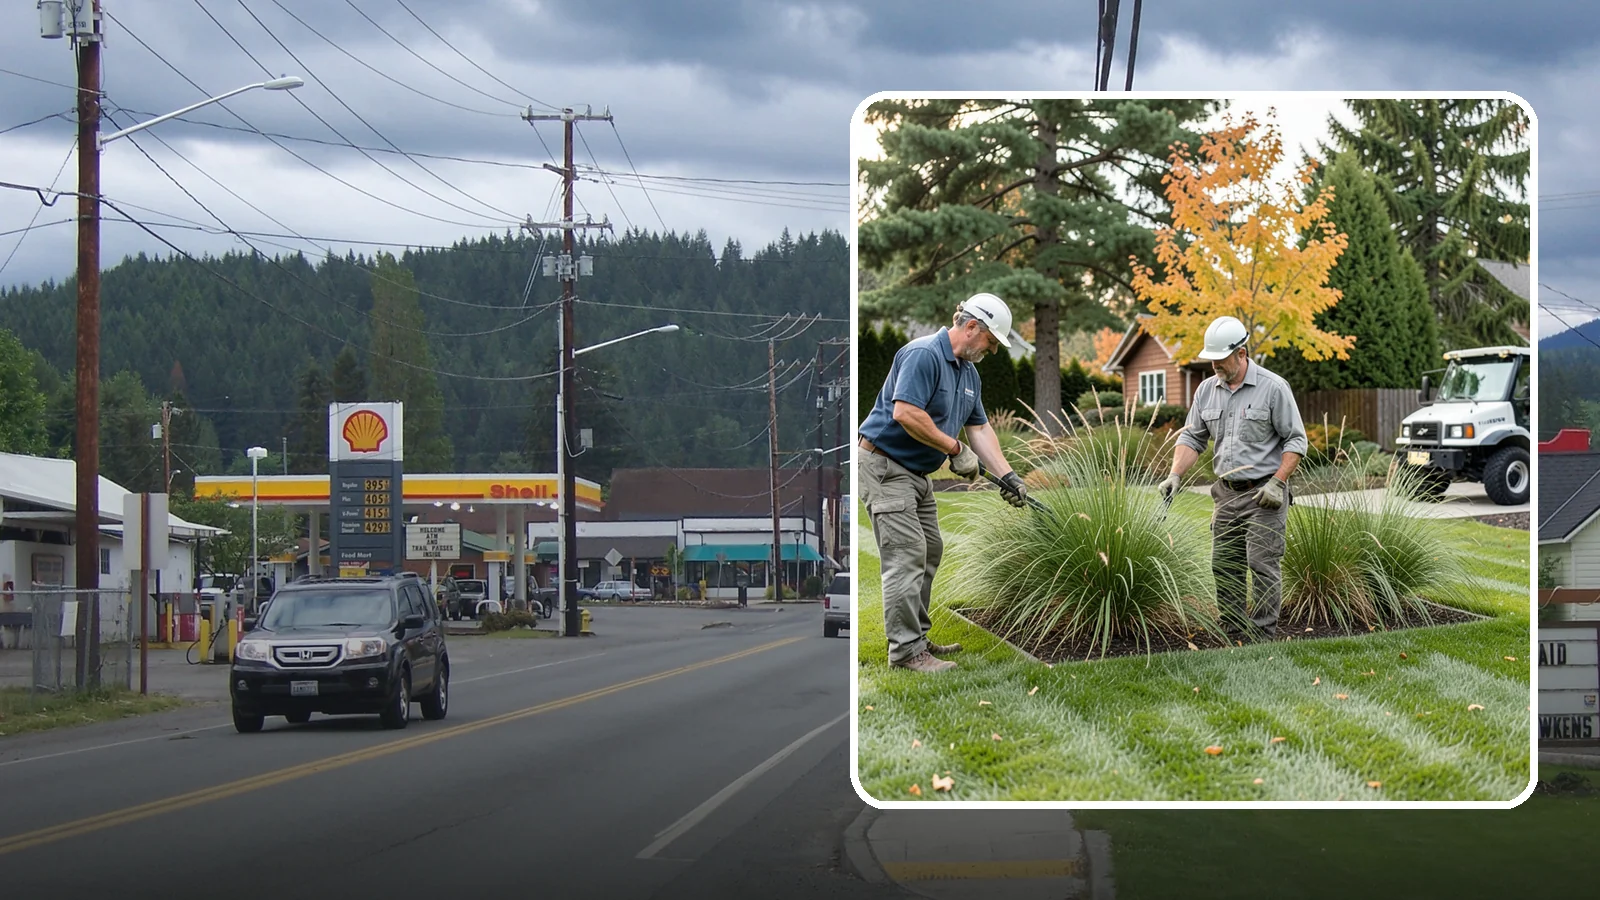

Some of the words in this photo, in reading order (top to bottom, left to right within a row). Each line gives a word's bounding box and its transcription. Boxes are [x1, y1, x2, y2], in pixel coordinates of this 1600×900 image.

[366, 480, 383, 490] 395
[490, 484, 548, 499] Shell
[366, 494, 383, 504] 405
[366, 508, 383, 518] 415
[366, 522, 383, 532] 429
